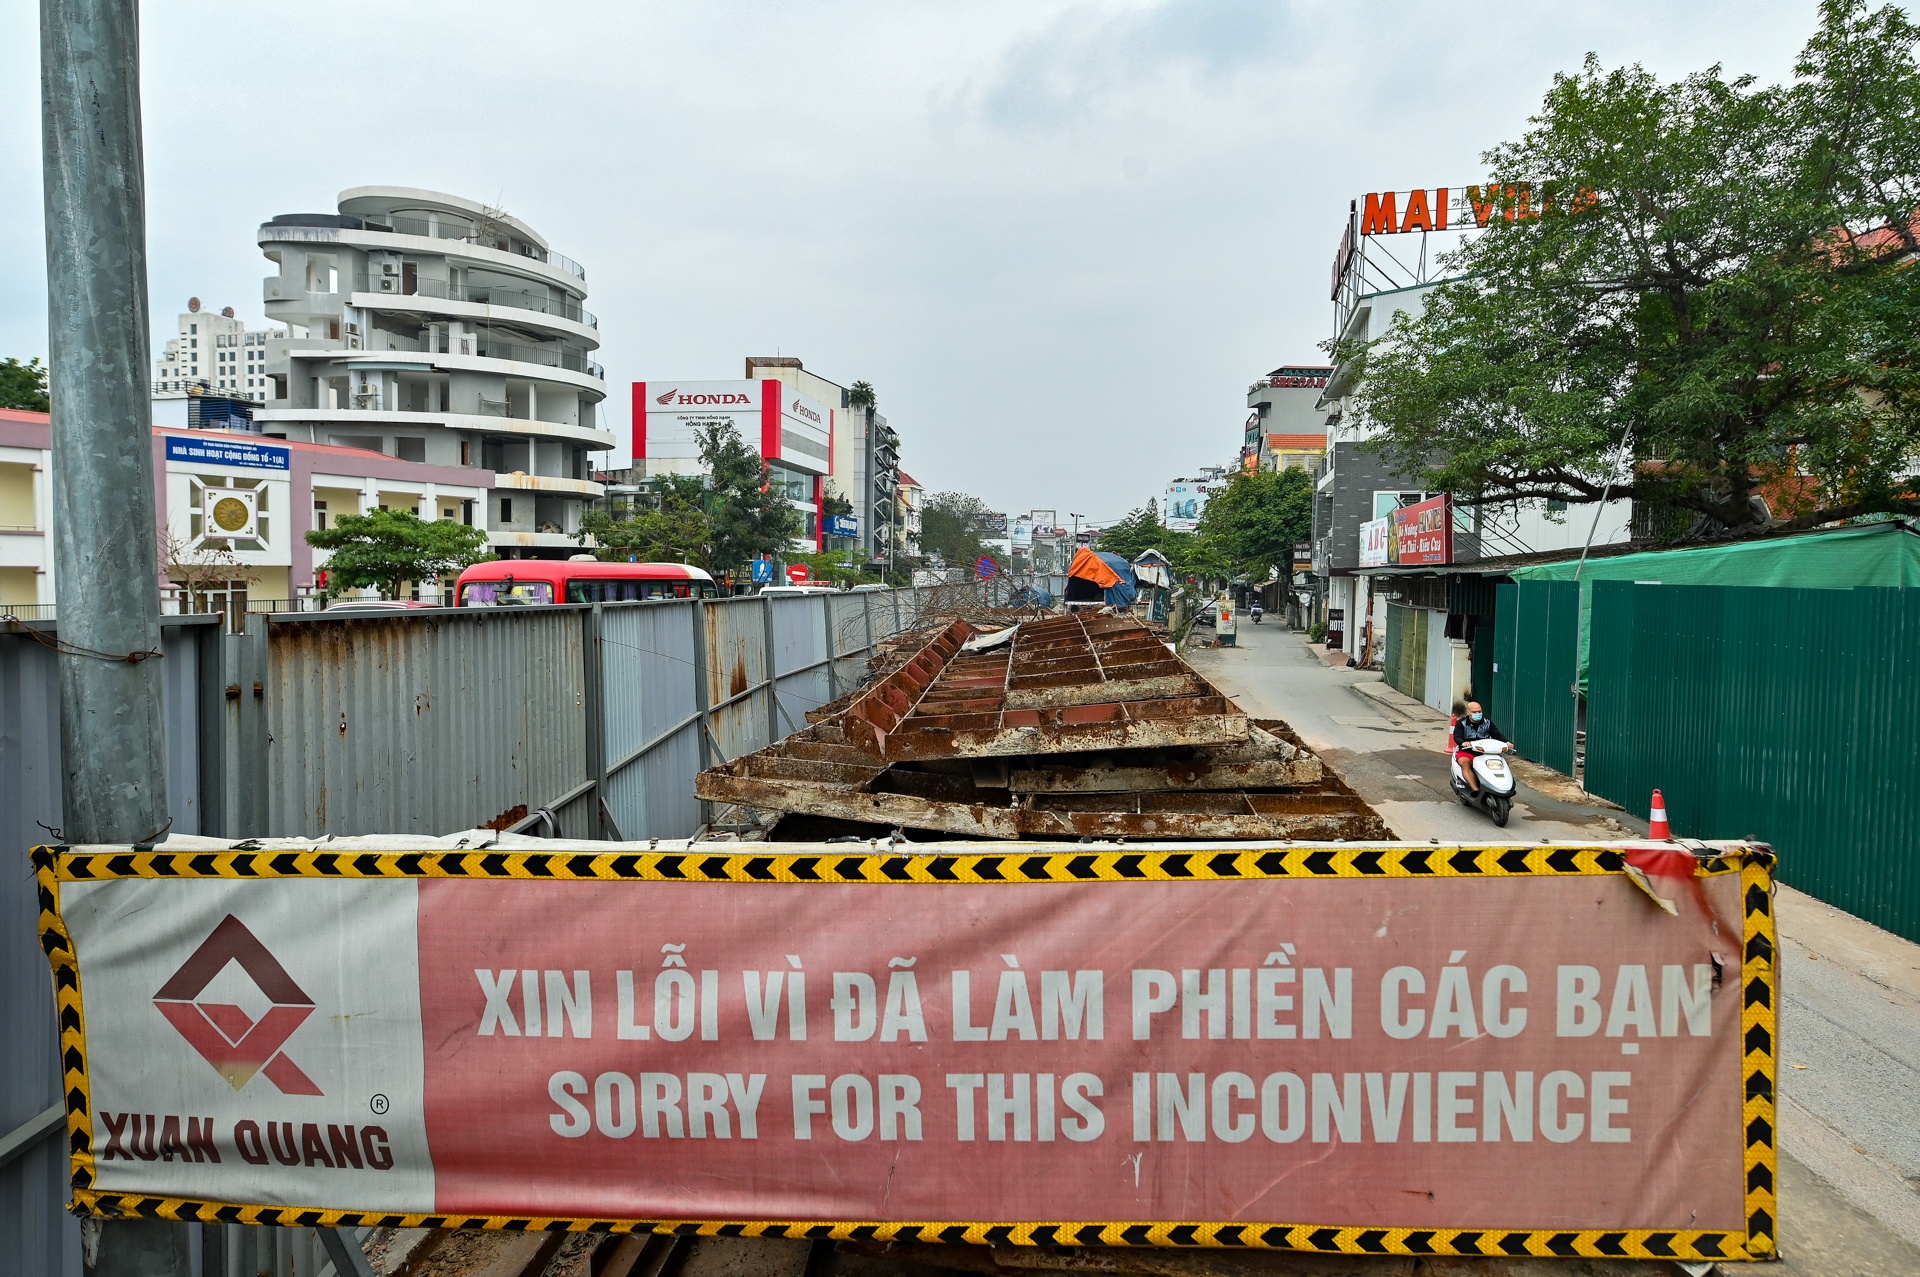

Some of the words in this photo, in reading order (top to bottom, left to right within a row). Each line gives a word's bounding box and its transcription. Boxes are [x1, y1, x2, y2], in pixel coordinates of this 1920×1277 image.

[1361, 188, 1448, 235] MAI
[1467, 180, 1603, 229] VIL
[678, 393, 751, 405] HONDA
[800, 405, 821, 424] HONDA
[172, 446, 187, 456] NHÀ
[188, 447, 205, 457] SINH
[206, 448, 223, 460] HOẠT
[224, 450, 242, 461] CỘNG
[1368, 526, 1386, 551] ABC
[476, 969, 592, 1038] XIN
[616, 943, 719, 1042] LỖI
[743, 955, 807, 1042] VÌ
[830, 957, 928, 1042] ĐÃ
[952, 954, 1105, 1042] LÀM
[1132, 942, 1353, 1040] PHIỀN
[1380, 950, 1528, 1039] CÁC
[1556, 964, 1713, 1054] BẠN
[548, 1070, 767, 1139] SORRY
[792, 1074, 923, 1141] FOR
[946, 1072, 1105, 1142] THIS
[1132, 1070, 1632, 1143] INCONVIENCE
[99, 1111, 222, 1164] XUAN
[234, 1119, 394, 1171] QUANG
